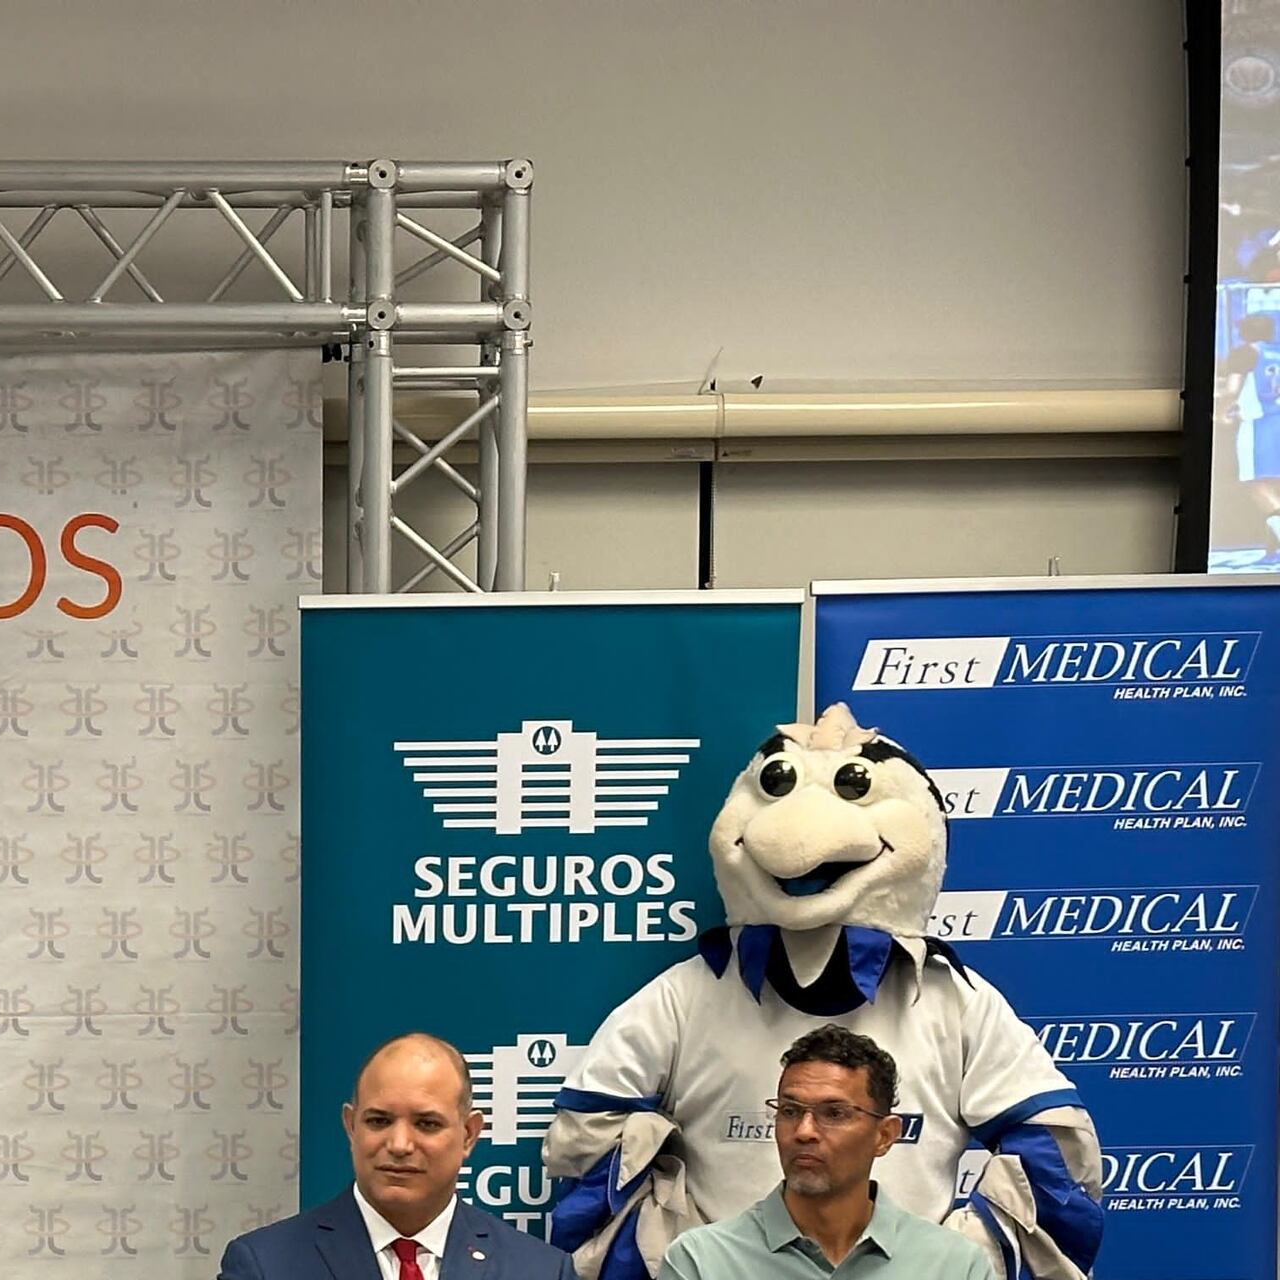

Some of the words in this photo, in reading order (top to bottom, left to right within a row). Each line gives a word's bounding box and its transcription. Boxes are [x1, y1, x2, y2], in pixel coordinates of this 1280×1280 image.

[870, 647, 981, 686] First
[1002, 640, 1241, 683] MEDICAL
[1113, 687, 1172, 700] HEALTH
[1173, 686, 1214, 699] PLAN,
[1218, 685, 1247, 697] INC.
[1002, 770, 1241, 813] MEDICAL
[1113, 818, 1172, 830] HEALTH
[1173, 817, 1215, 829] PLAN,
[1218, 816, 1248, 828] INC.
[414, 853, 676, 898] SEGUROS
[392, 900, 697, 945] MULTIPLES
[1001, 893, 1239, 936] MEDICAL
[1111, 940, 1170, 952] HEALTH
[1171, 939, 1213, 951] PLAN,
[1217, 938, 1245, 950] INC.
[1109, 1067, 1168, 1079] HEALTH
[1169, 1066, 1211, 1078] PLAN,
[1216, 1065, 1243, 1077] INC.
[727, 1115, 775, 1139] First
[1107, 1198, 1166, 1210] HEALTH
[1167, 1198, 1210, 1210] PLAN,
[1213, 1197, 1241, 1209] INC.
